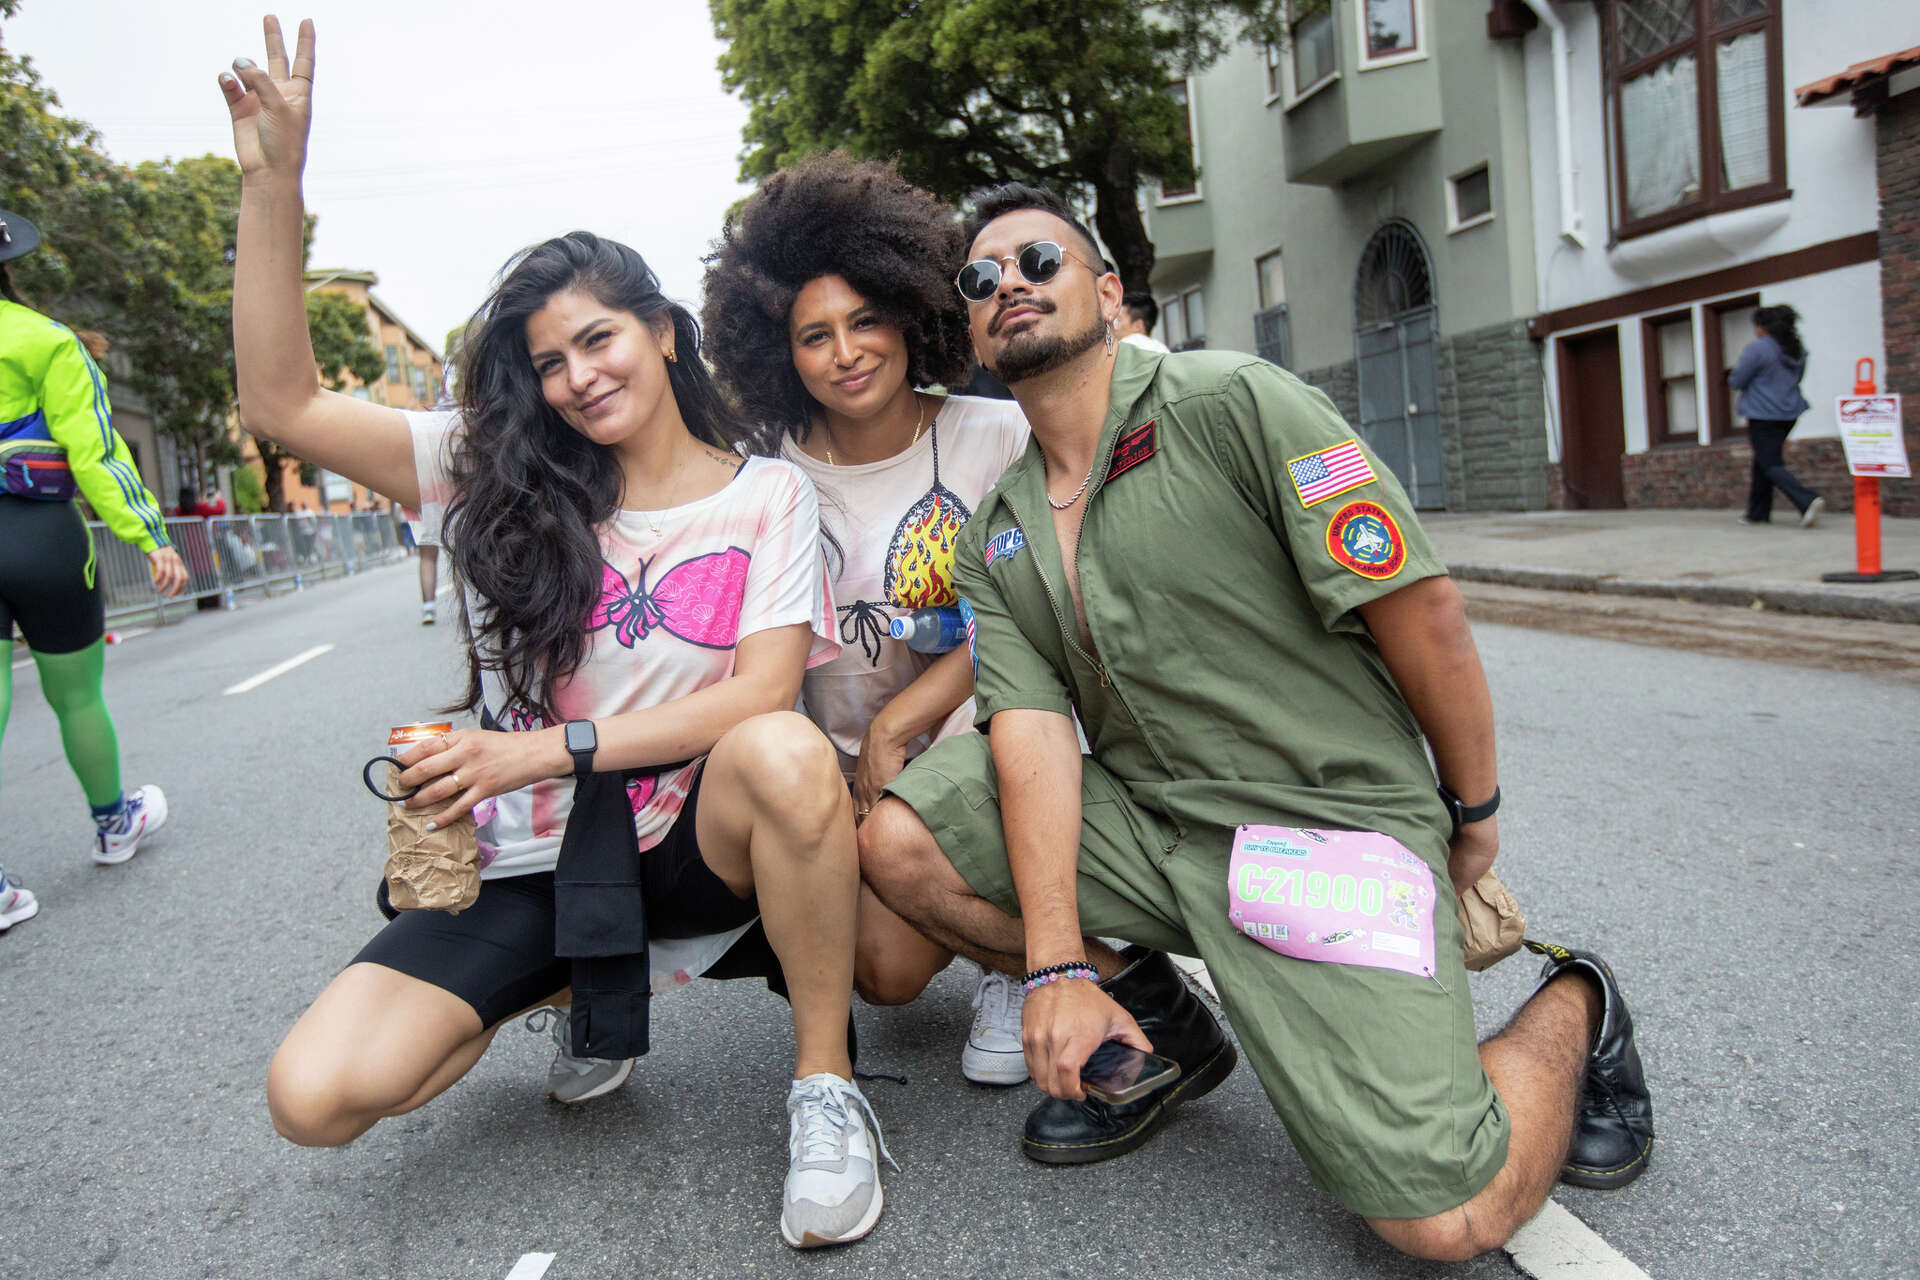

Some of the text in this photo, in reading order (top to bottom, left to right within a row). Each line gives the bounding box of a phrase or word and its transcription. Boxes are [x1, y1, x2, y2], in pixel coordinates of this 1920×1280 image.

[1332, 505, 1387, 536] UNITED STATES
[1237, 864, 1384, 916] C21900
